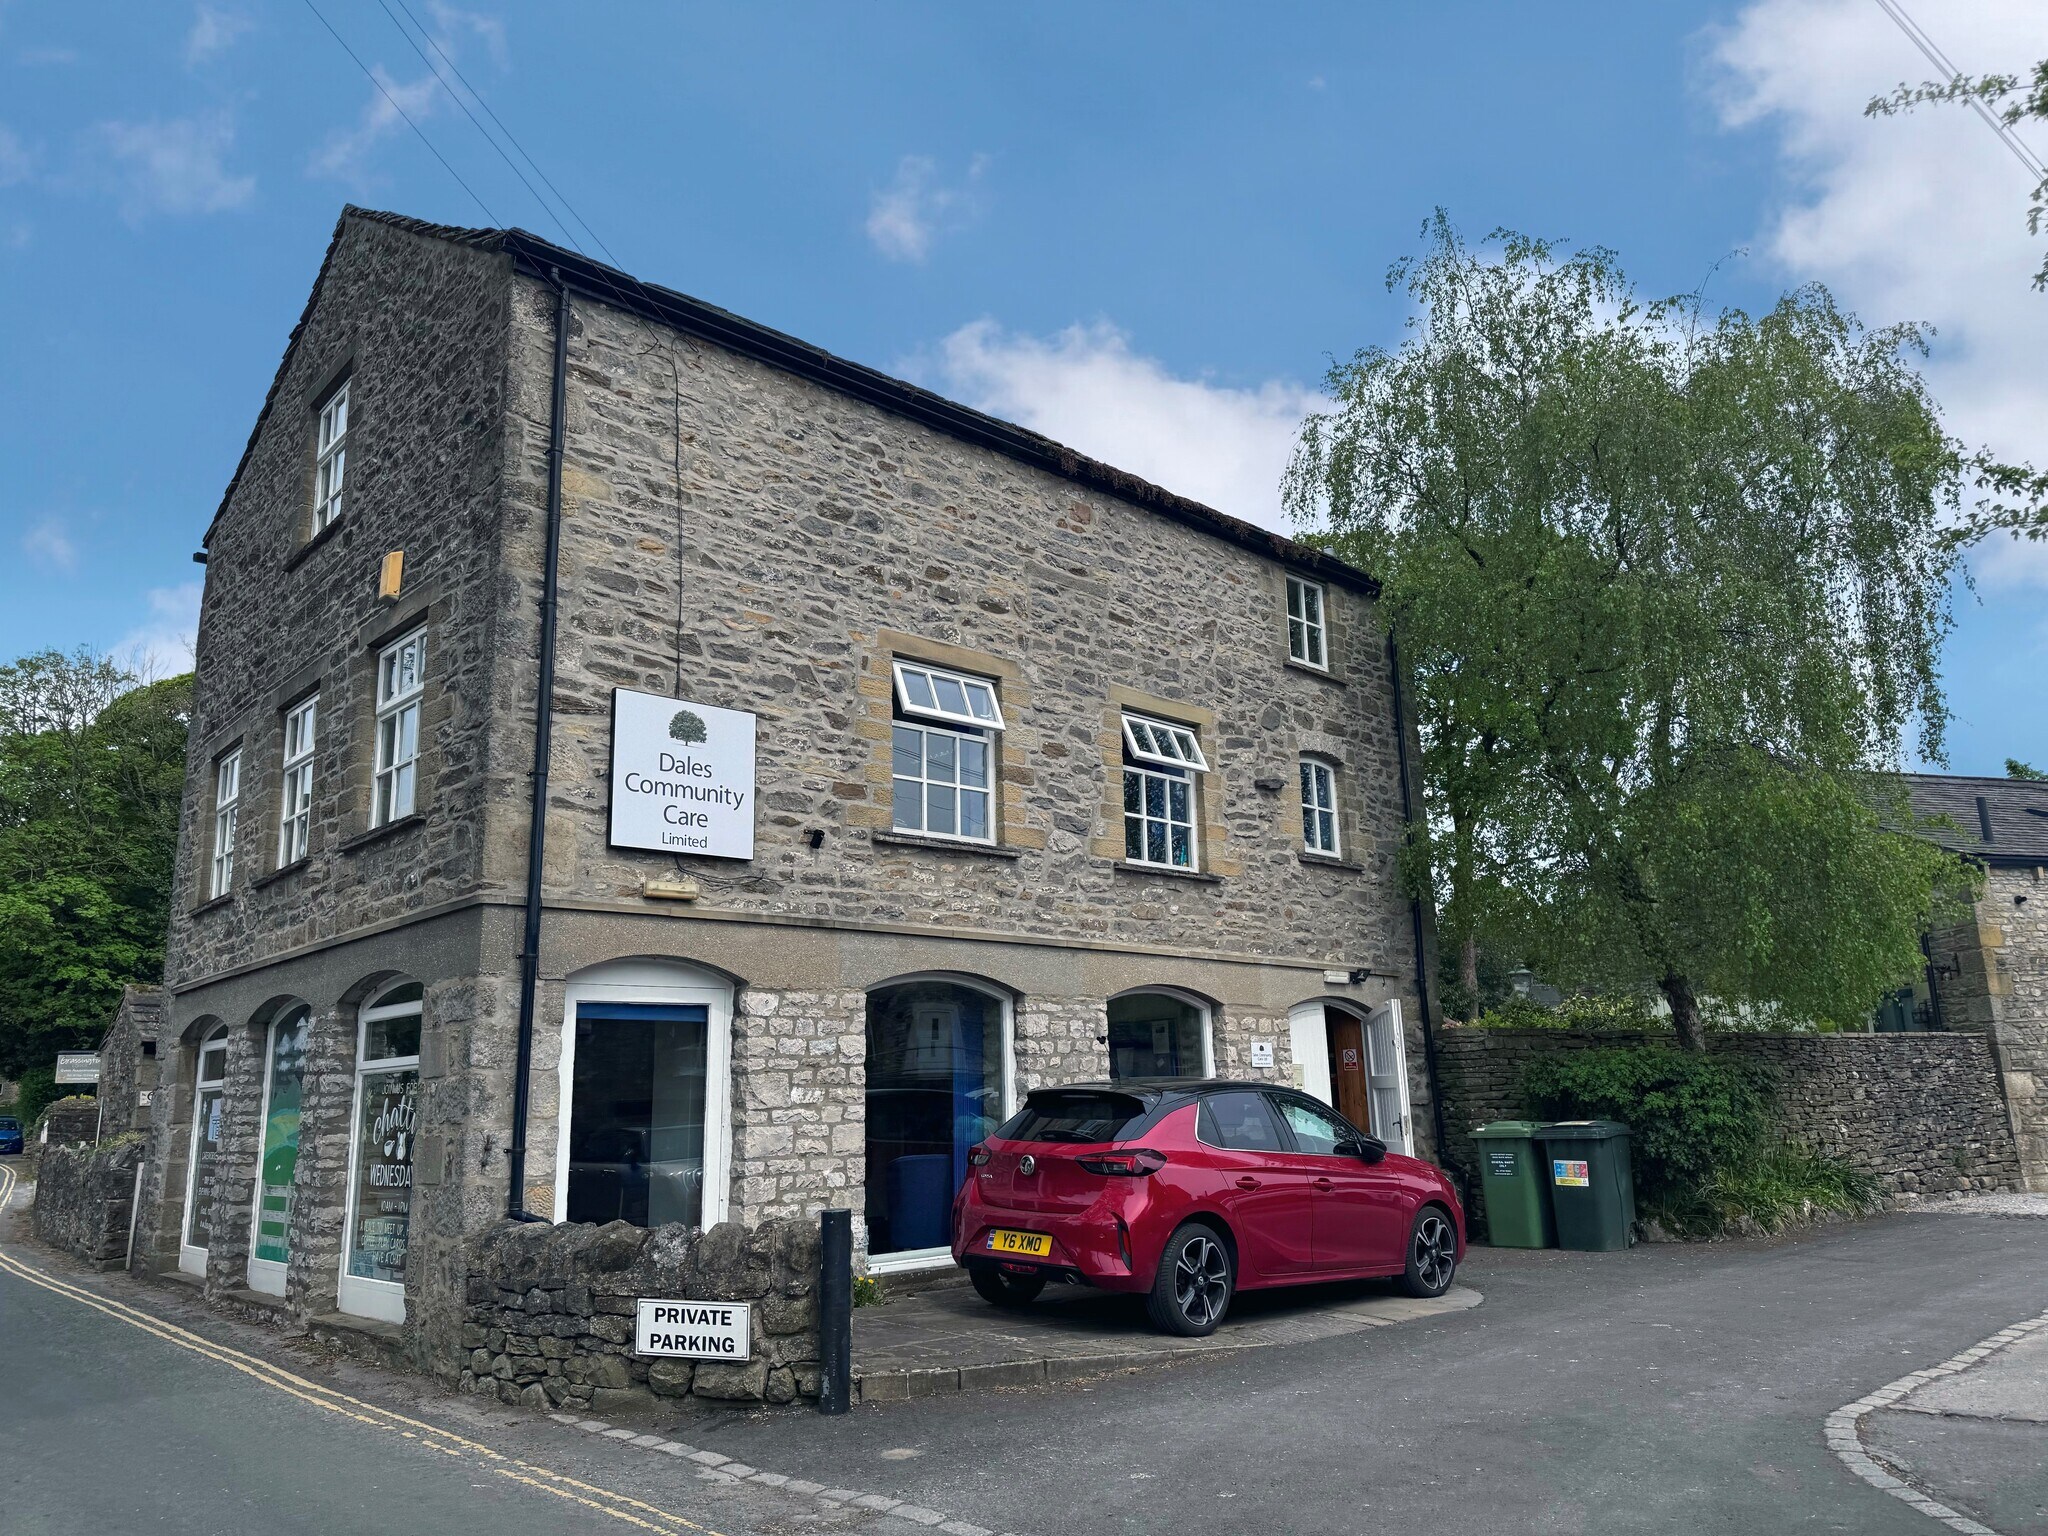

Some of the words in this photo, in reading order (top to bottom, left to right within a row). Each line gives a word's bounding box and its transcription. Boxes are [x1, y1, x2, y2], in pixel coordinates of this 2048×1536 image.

[659, 752, 713, 778] Dales
[625, 772, 744, 811] Community
[663, 805, 709, 828] Care
[661, 831, 708, 849] Limited
[1003, 1232, 1017, 1249] Y6
[1018, 1234, 1042, 1252] XMO
[654, 1307, 733, 1327] PRIVATE
[649, 1333, 735, 1354] PARKING
